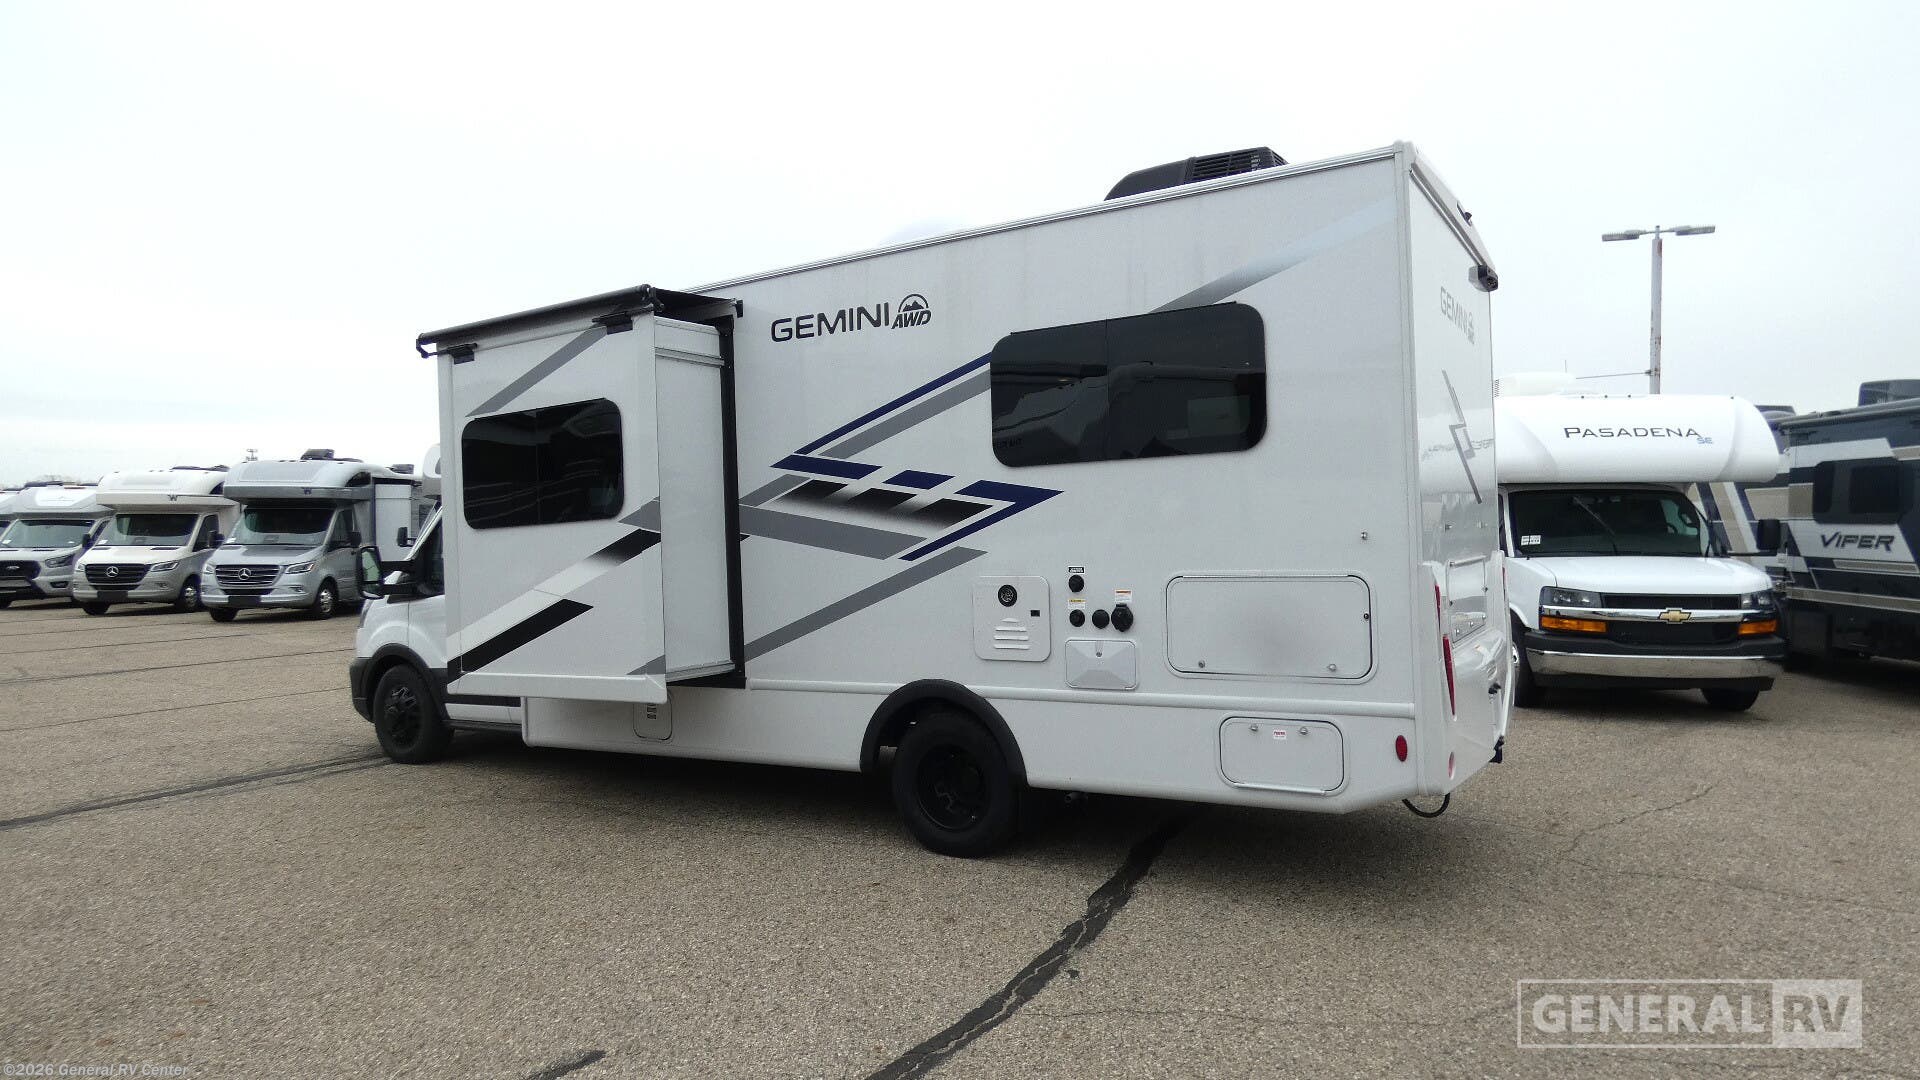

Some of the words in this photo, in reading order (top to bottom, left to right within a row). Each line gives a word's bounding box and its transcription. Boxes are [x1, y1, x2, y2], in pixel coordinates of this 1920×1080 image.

[771, 302, 889, 342] GEMINI
[891, 310, 932, 330] AWD
[1564, 427, 1701, 438] PASADENA
[1821, 531, 1895, 552] VIPER
